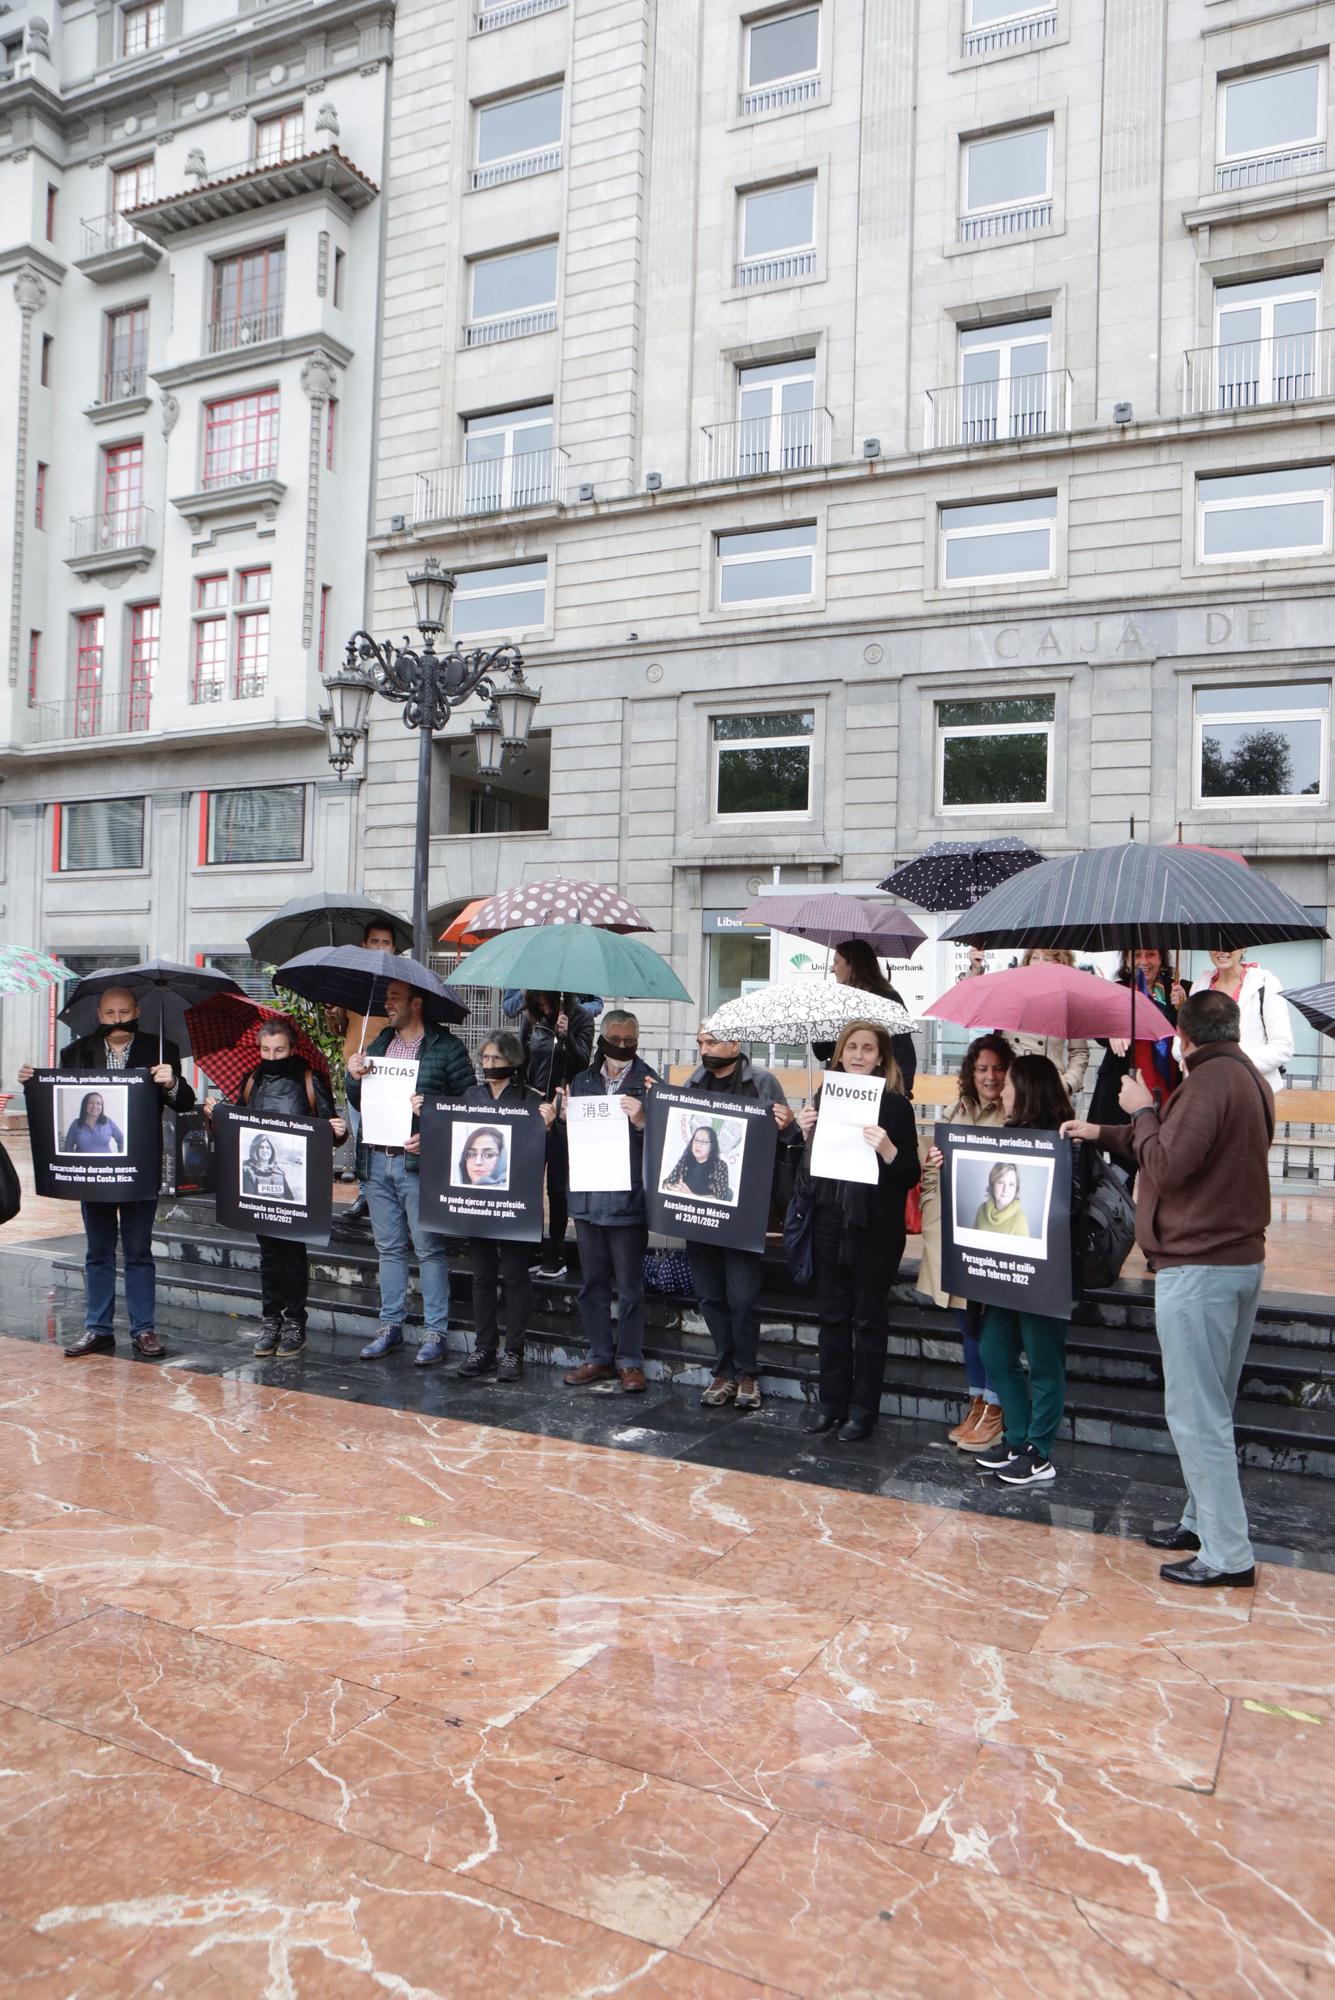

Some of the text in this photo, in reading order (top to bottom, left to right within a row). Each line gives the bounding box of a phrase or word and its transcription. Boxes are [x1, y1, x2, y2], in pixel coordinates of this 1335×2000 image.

[994, 608, 1271, 660] CAJA DE
[717, 916, 742, 927] Liber
[368, 1065, 416, 1078] OTICIAS
[80, 1076, 111, 1084] periodista.
[825, 1082, 878, 1102] Novosti
[452, 1104, 467, 1113] Sahel,
[469, 1105, 497, 1114] periodista.
[583, 1102, 611, 1118] 消息
[656, 1091, 767, 1116] Lourdes Maldonado, periodista. México.
[229, 1112, 249, 1122] Shireen
[262, 1117, 288, 1128] periodista.
[290, 1121, 315, 1132] Palestina.
[949, 1133, 1055, 1150] Elena Milashina, periodista. Rusia.
[49, 1163, 138, 1174] Encarcelada durante meses.
[55, 1174, 72, 1182] Ahora
[97, 1175, 115, 1183] Costa
[261, 1185, 282, 1193] PRESS
[239, 1201, 266, 1212] Asesinada
[276, 1207, 308, 1218] Cisjordania
[440, 1195, 447, 1203] No
[448, 1196, 464, 1205] puede
[465, 1197, 486, 1207] ejercer
[496, 1200, 527, 1210] profesión.
[663, 1200, 730, 1220] Asesinada en México
[261, 1213, 293, 1223] 11/05/2022
[449, 1205, 456, 1213] Ha
[457, 1206, 492, 1216] abandonado
[493, 1209, 500, 1217] su
[675, 1213, 720, 1228] el 23/01/2022
[962, 1252, 1036, 1274] Perseguida, en el exilio
[968, 1265, 1030, 1286] desde febrero 2022
